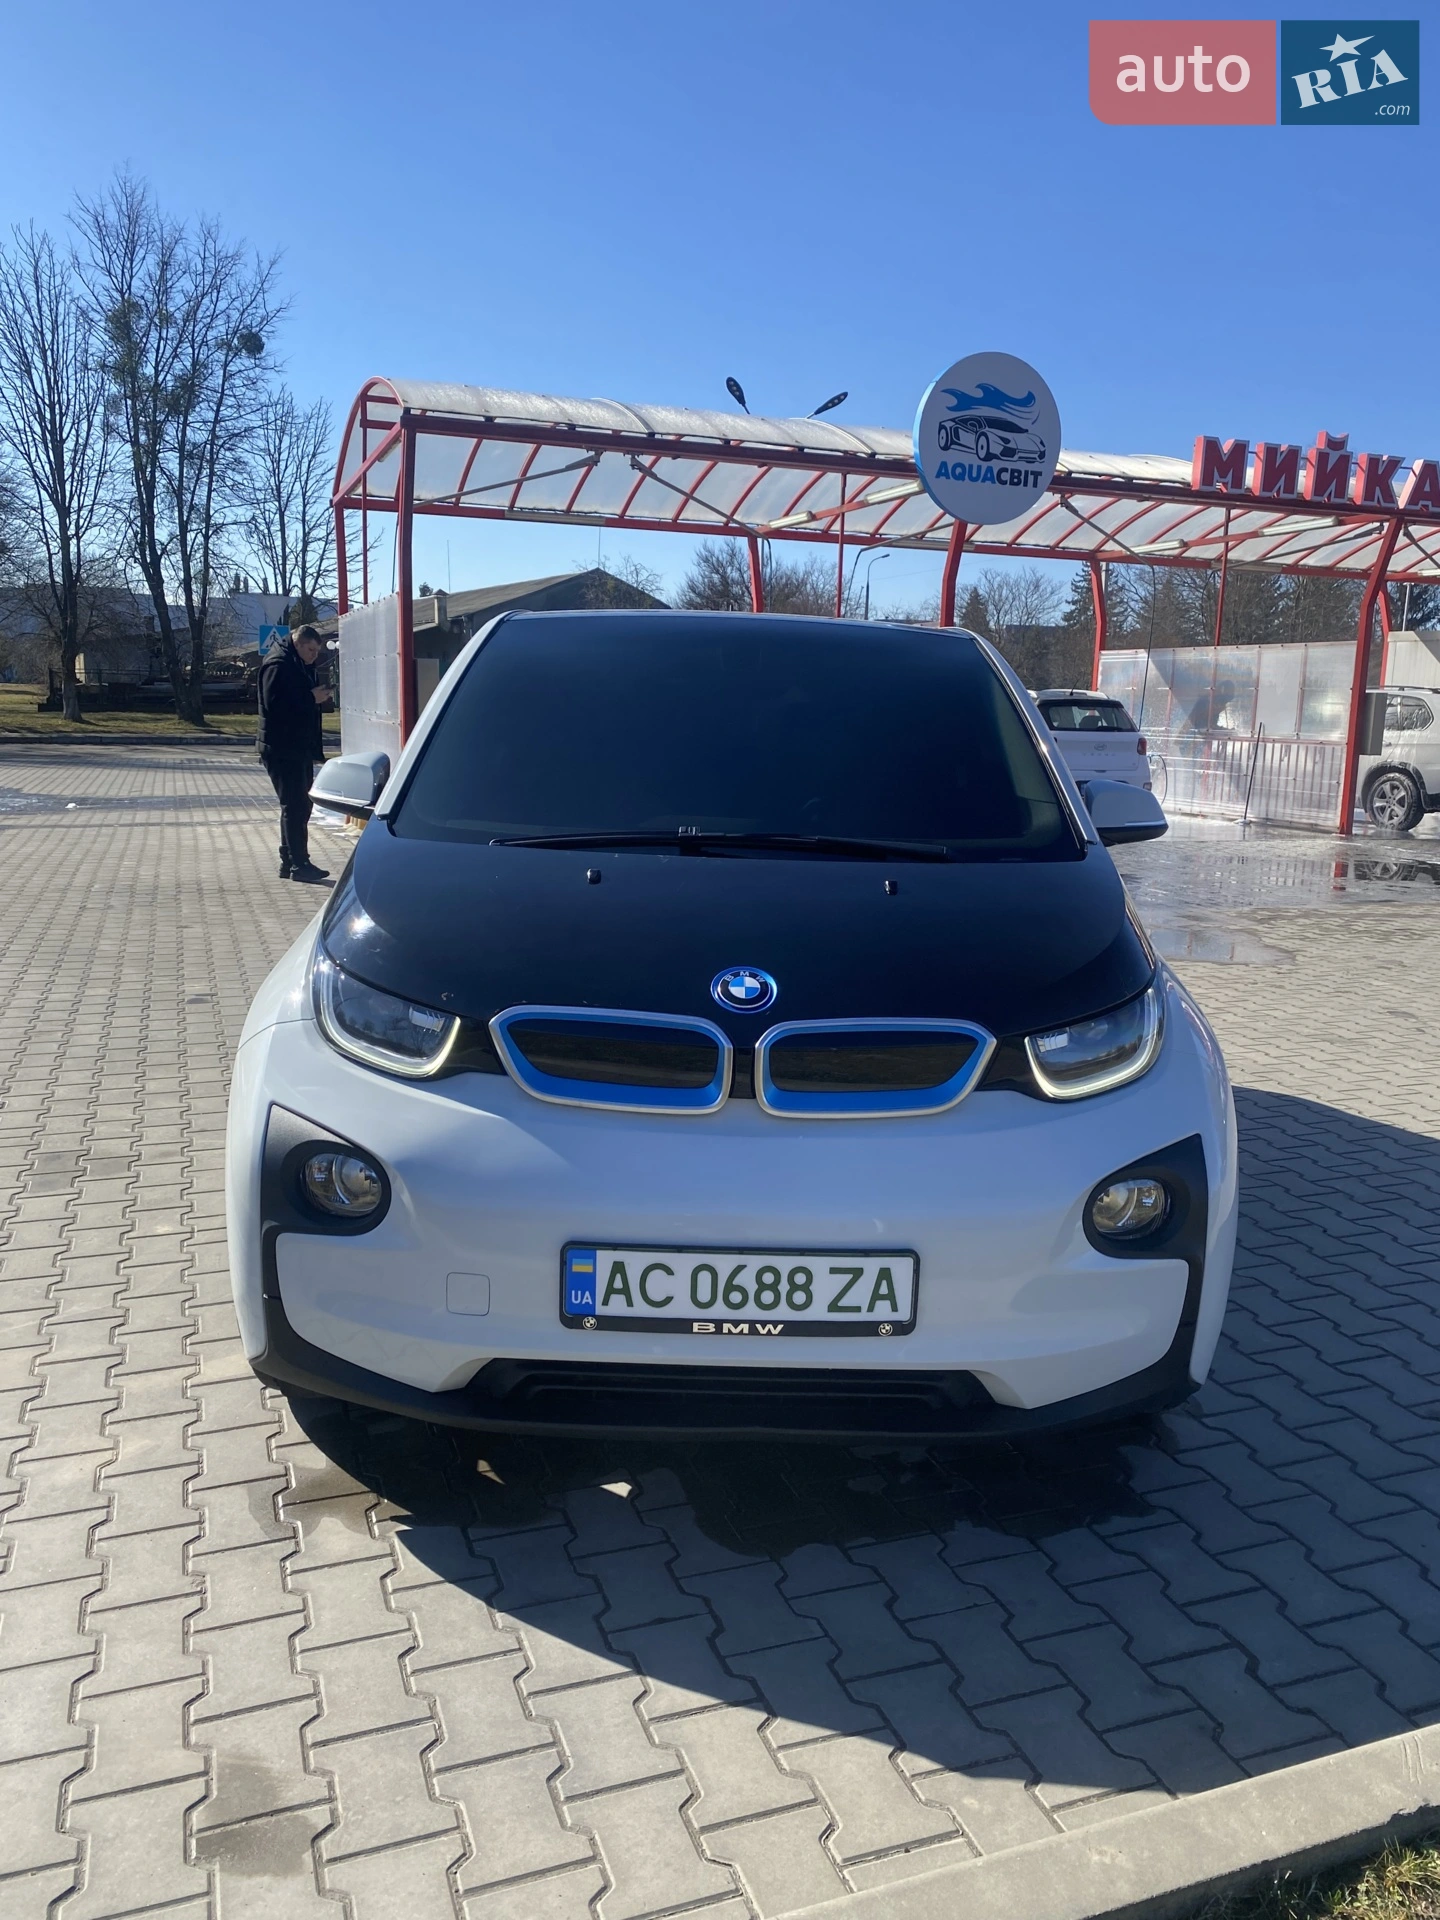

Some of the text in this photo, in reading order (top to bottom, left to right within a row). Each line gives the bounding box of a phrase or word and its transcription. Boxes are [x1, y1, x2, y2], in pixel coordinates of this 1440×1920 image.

[1193, 430, 1440, 511] МИЙКА
[724, 971, 765, 982] BMW
[601, 1260, 899, 1313] AC 0688 ZA
[571, 1290, 592, 1305] UA
[692, 1322, 784, 1335] BMW
